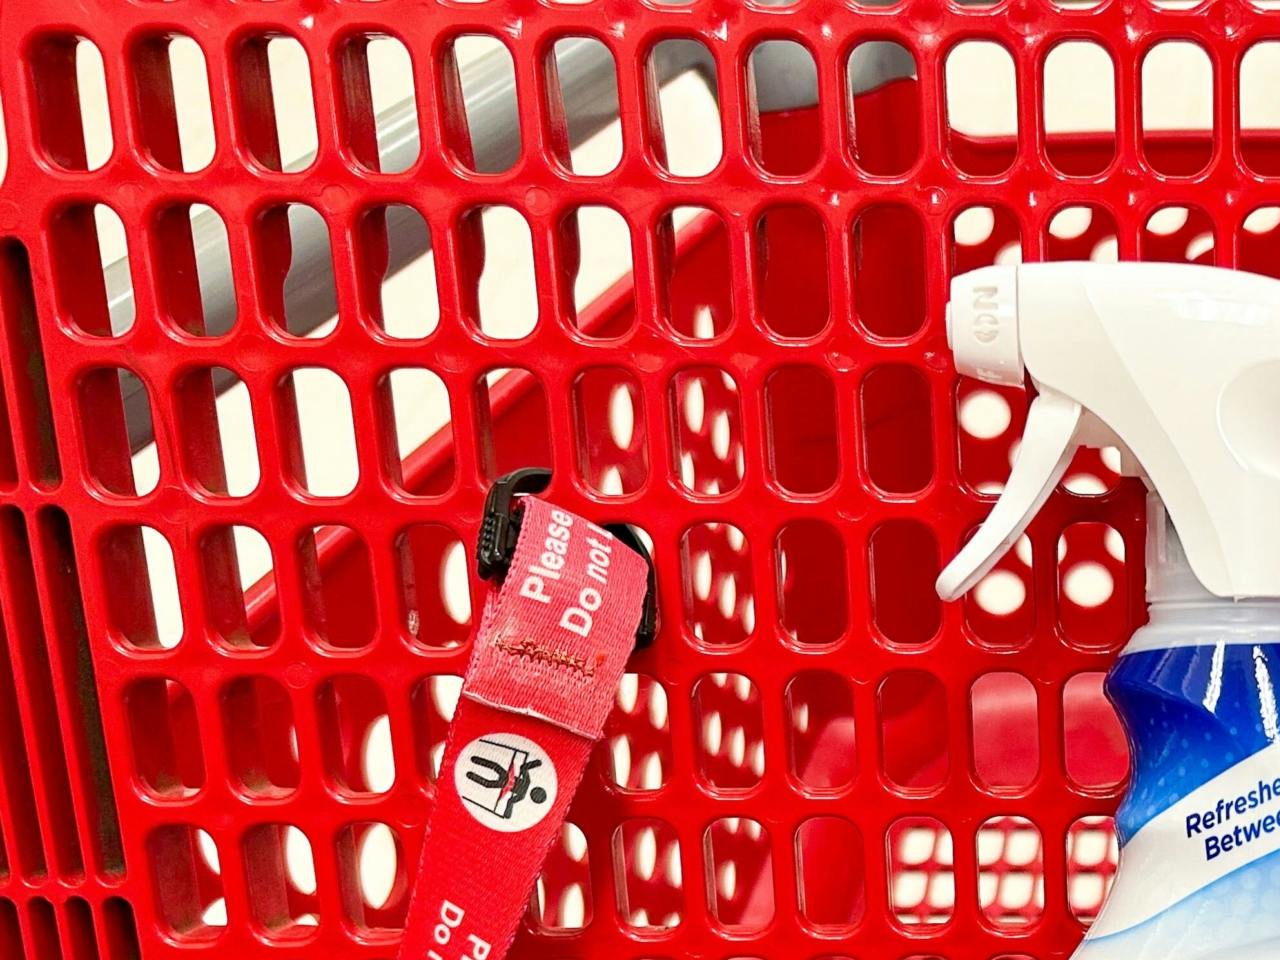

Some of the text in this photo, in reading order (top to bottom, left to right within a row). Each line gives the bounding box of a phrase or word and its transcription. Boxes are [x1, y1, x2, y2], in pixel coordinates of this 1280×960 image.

[519, 509, 575, 605] Please
[559, 588, 603, 638] Do
[586, 536, 612, 584] not
[434, 899, 465, 945] Do
